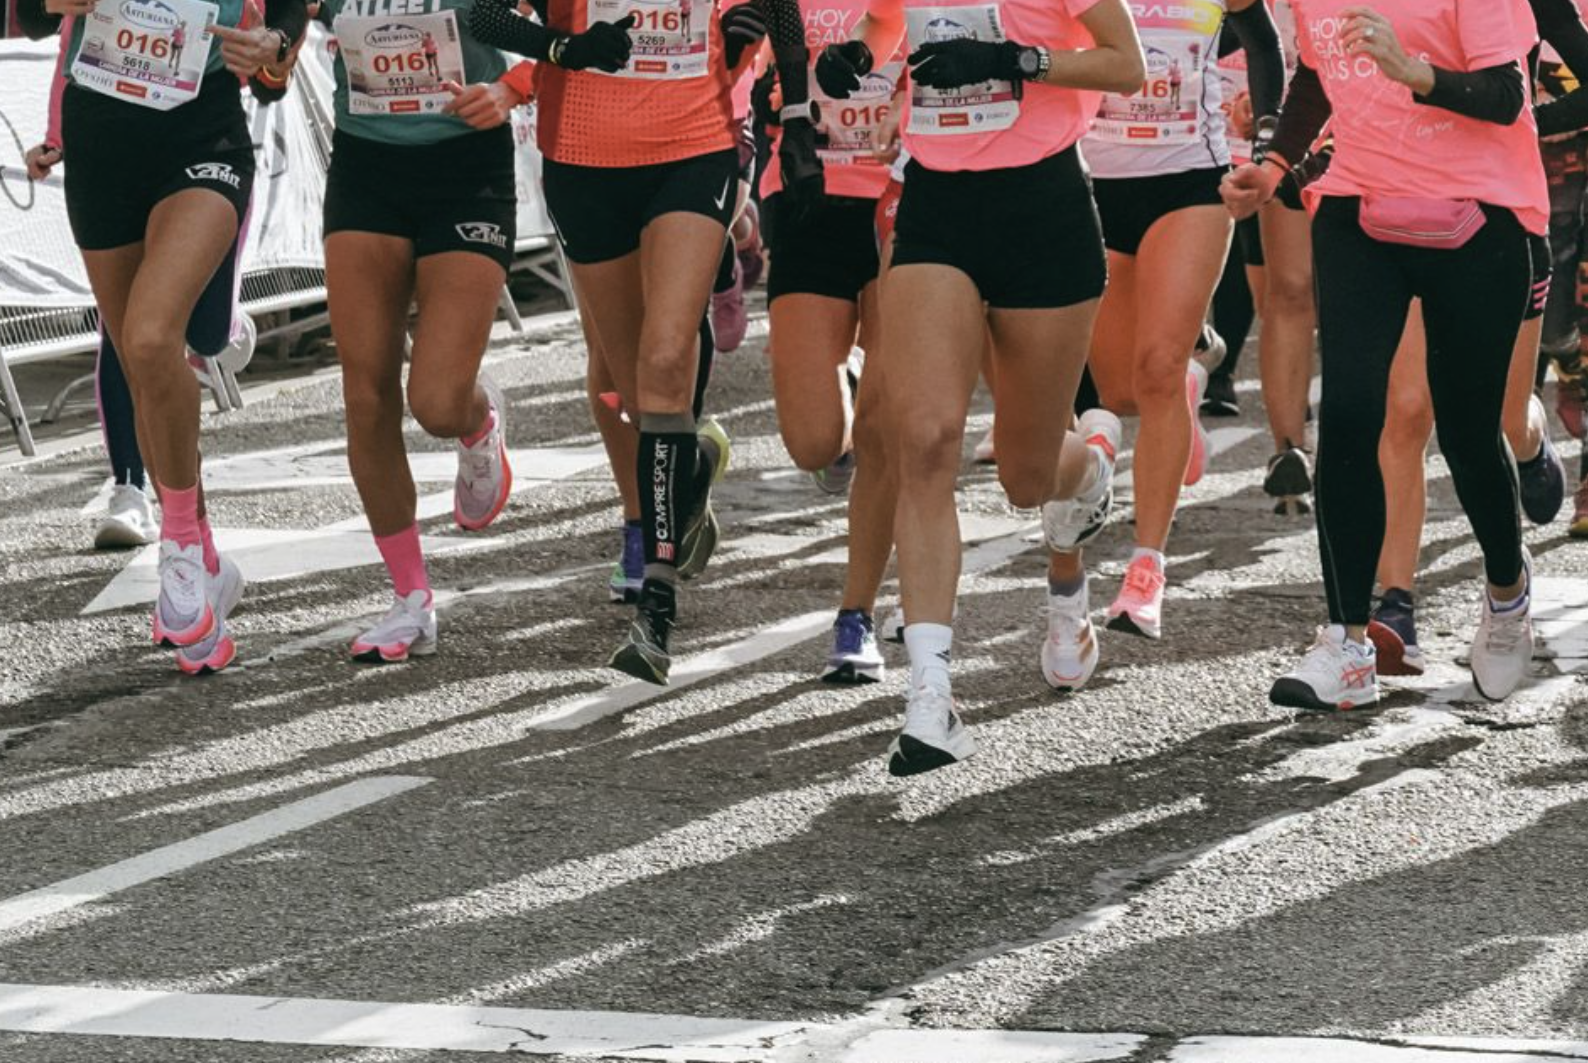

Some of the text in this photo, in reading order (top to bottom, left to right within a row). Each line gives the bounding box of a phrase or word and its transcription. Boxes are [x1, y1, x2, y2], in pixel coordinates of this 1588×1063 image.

[628, 9, 679, 31] 016
[805, 8, 852, 27] HOY
[1308, 17, 1348, 40] HOY
[117, 29, 169, 59] 016
[638, 36, 665, 46] 5269
[122, 56, 151, 71] 5618
[373, 53, 424, 74] 016
